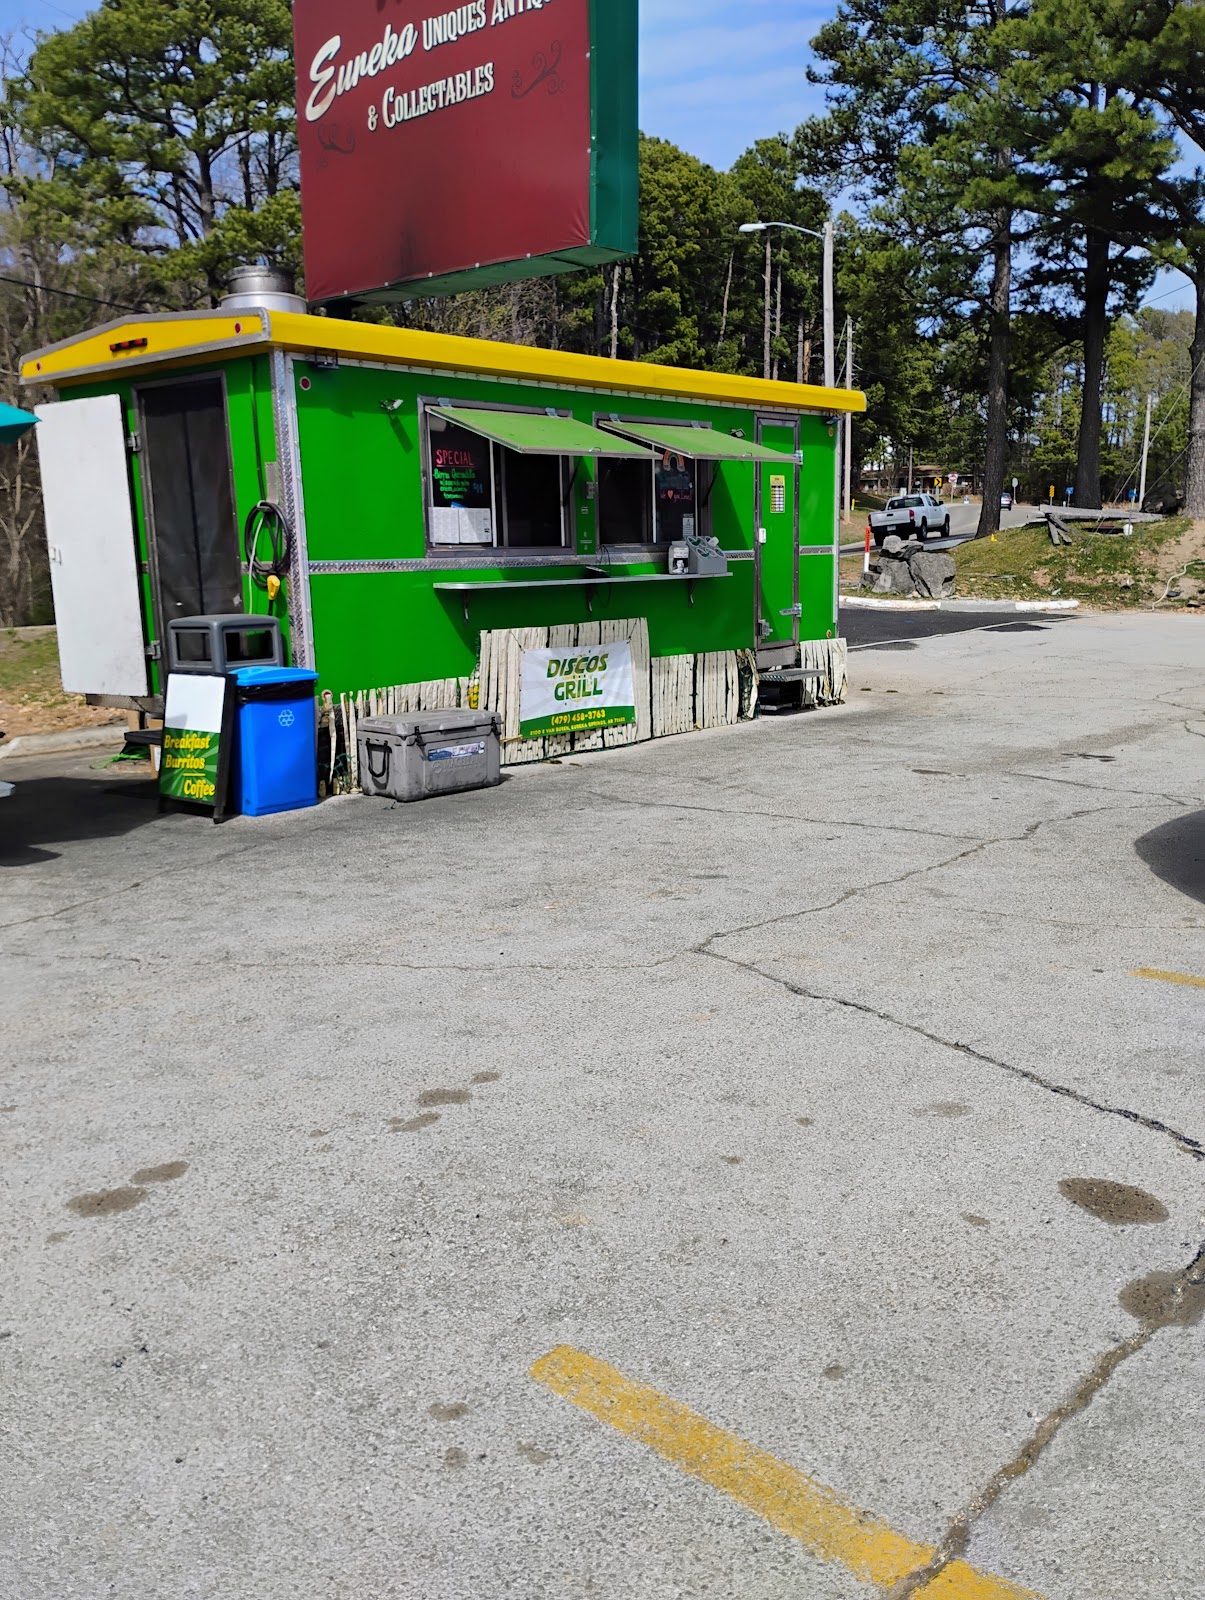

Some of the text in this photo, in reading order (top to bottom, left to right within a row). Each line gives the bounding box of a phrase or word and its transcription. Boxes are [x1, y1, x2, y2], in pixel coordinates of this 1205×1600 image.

[305, 22, 418, 122] Eureka
[421, 0, 487, 51] UNIQUES
[367, 62, 495, 132] & COLLECTABLES
[436, 449, 474, 466] SPECIAL
[546, 653, 609, 678] DISCOS
[554, 677, 603, 701] GRILL
[551, 709, 606, 726] (479) 458-3763
[571, 722, 588, 730] EUREKA
[164, 733, 211, 752] Breakfast
[165, 753, 205, 769] Burritos
[183, 779, 215, 798] Coffee
